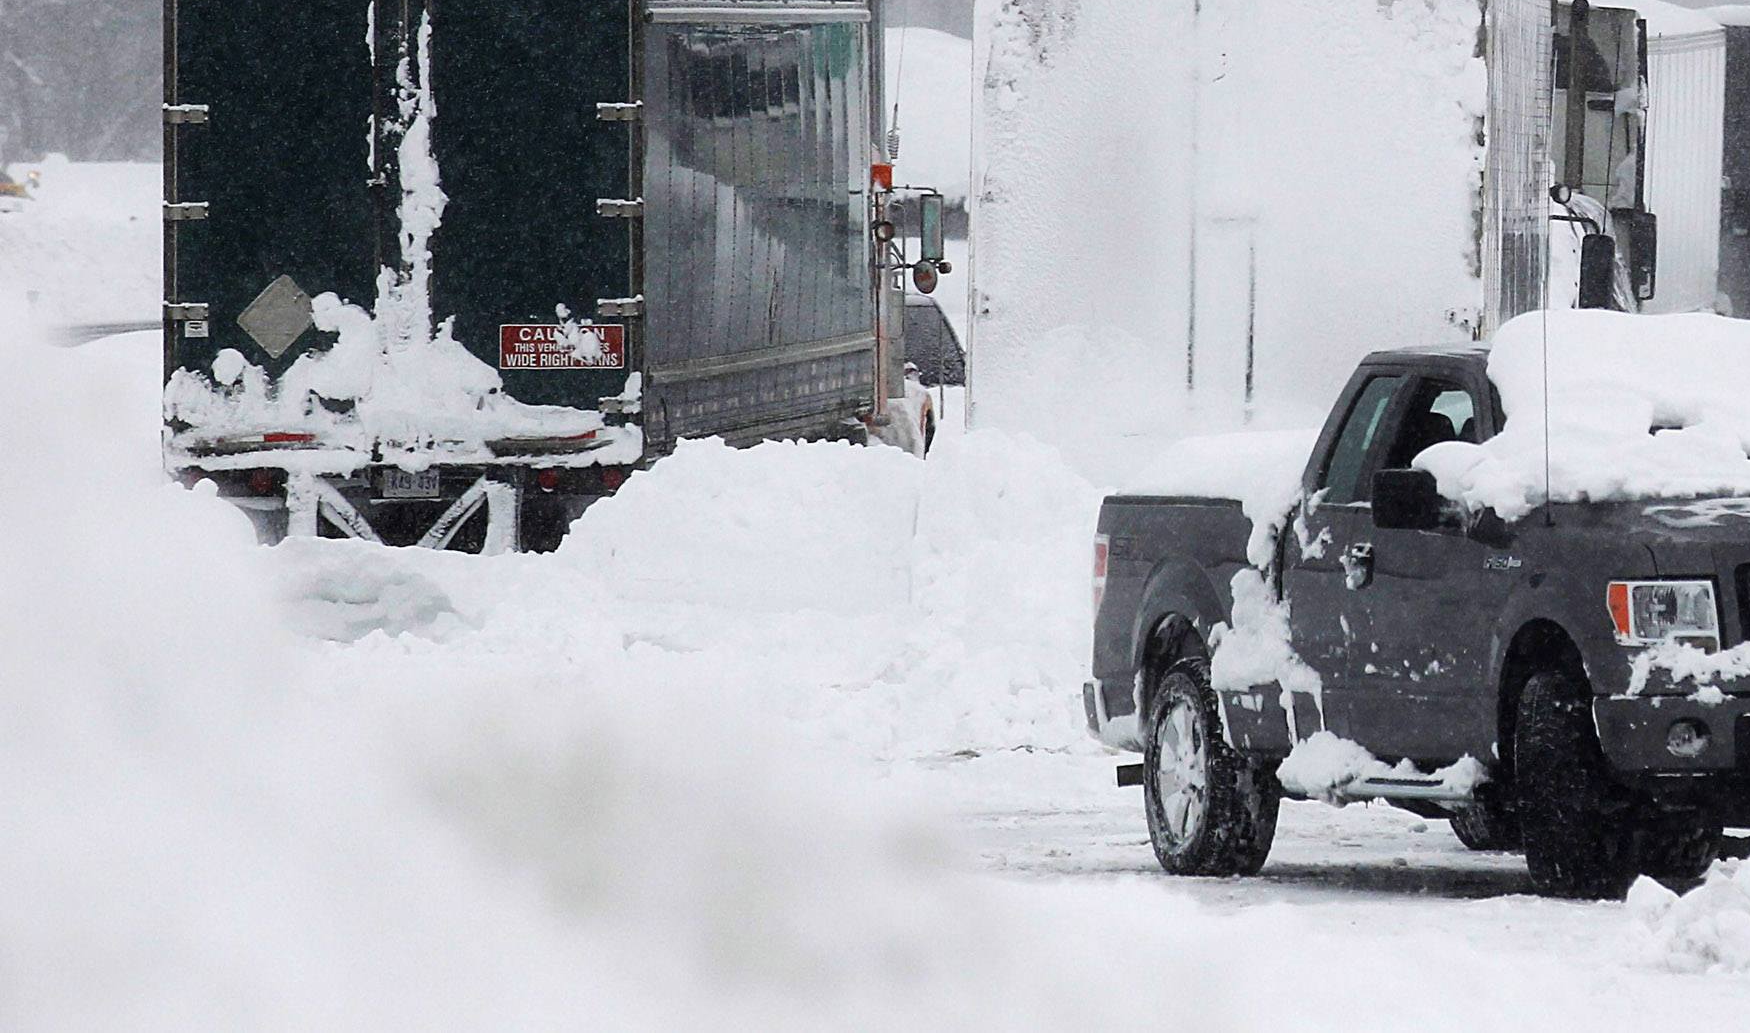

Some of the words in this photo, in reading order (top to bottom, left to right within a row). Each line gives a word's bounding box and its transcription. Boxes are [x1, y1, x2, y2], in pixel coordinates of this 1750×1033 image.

[519, 328, 605, 341] CAUN
[514, 343, 535, 353] THIS
[506, 353, 537, 366] WIDE
